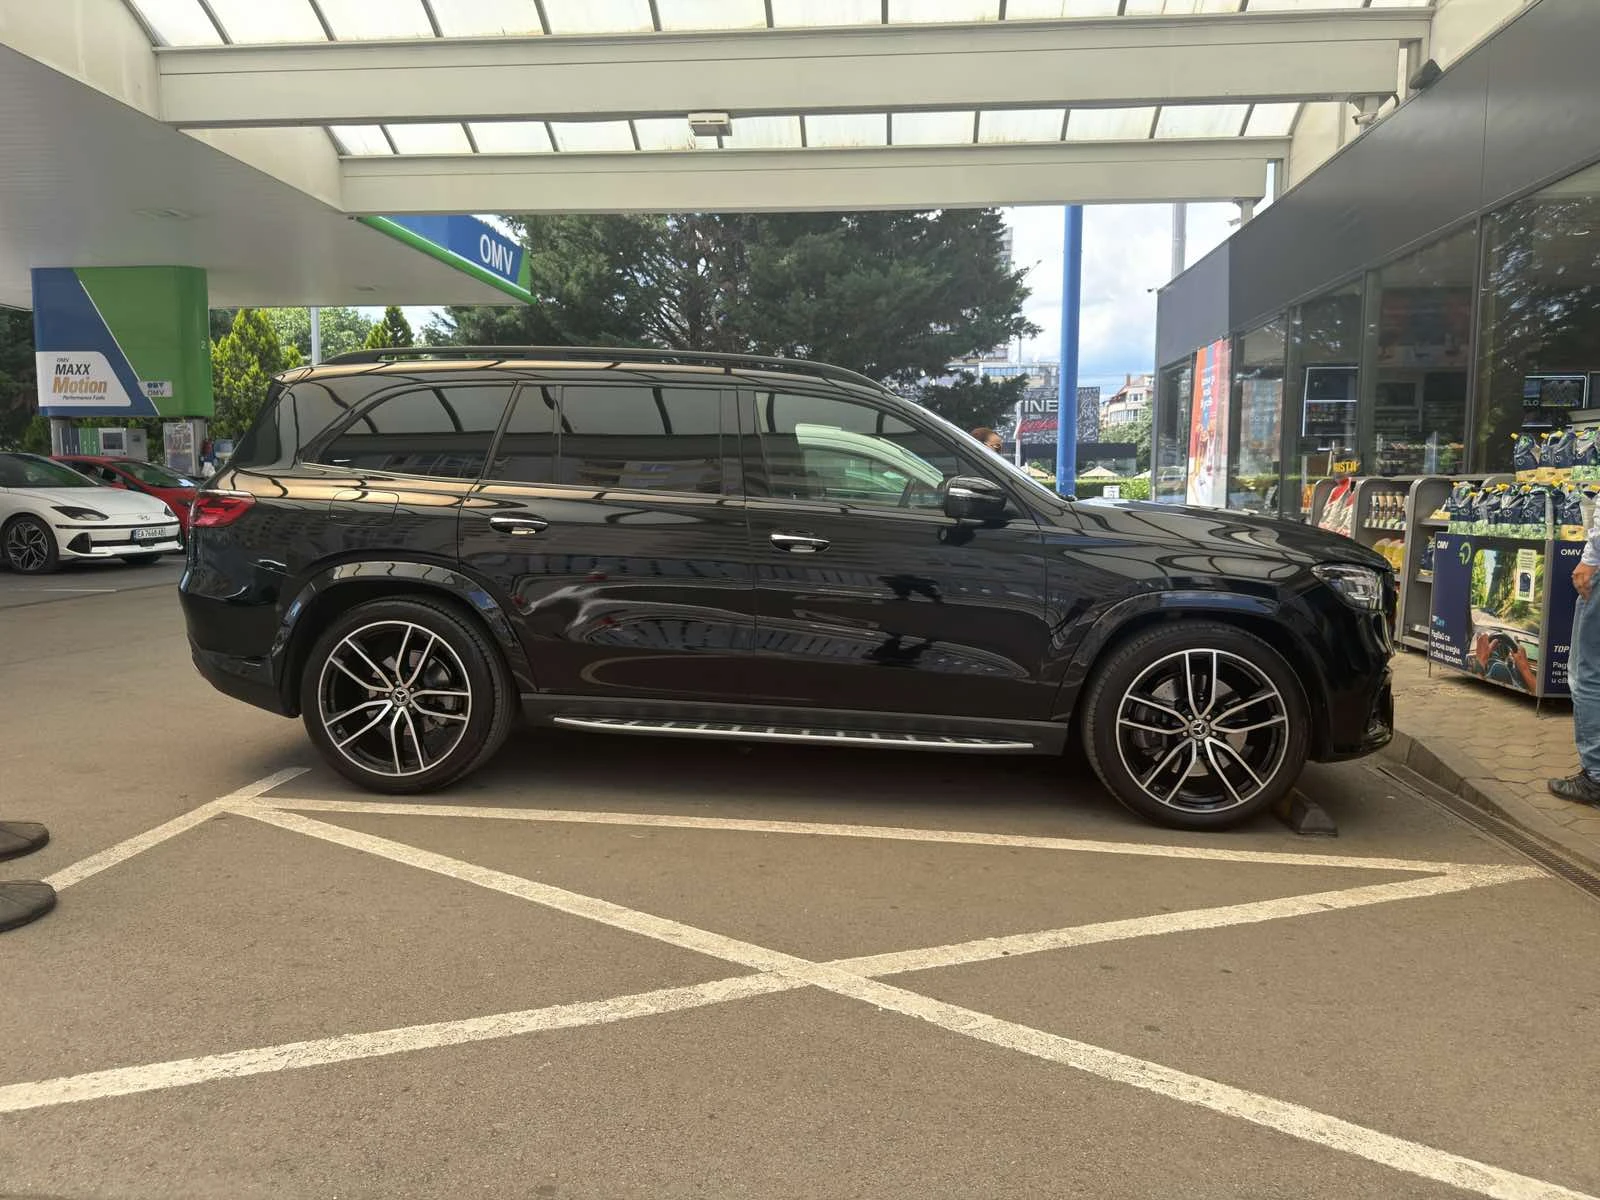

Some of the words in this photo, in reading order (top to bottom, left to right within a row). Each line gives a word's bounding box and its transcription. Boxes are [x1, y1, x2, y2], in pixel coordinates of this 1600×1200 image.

[480, 233, 513, 275] OMV
[55, 363, 91, 376] MAXX
[52, 376, 108, 394] Motion
[1436, 540, 1449, 550] OMV
[1560, 548, 1582, 556] OMV
[1553, 645, 1570, 653] TOP
